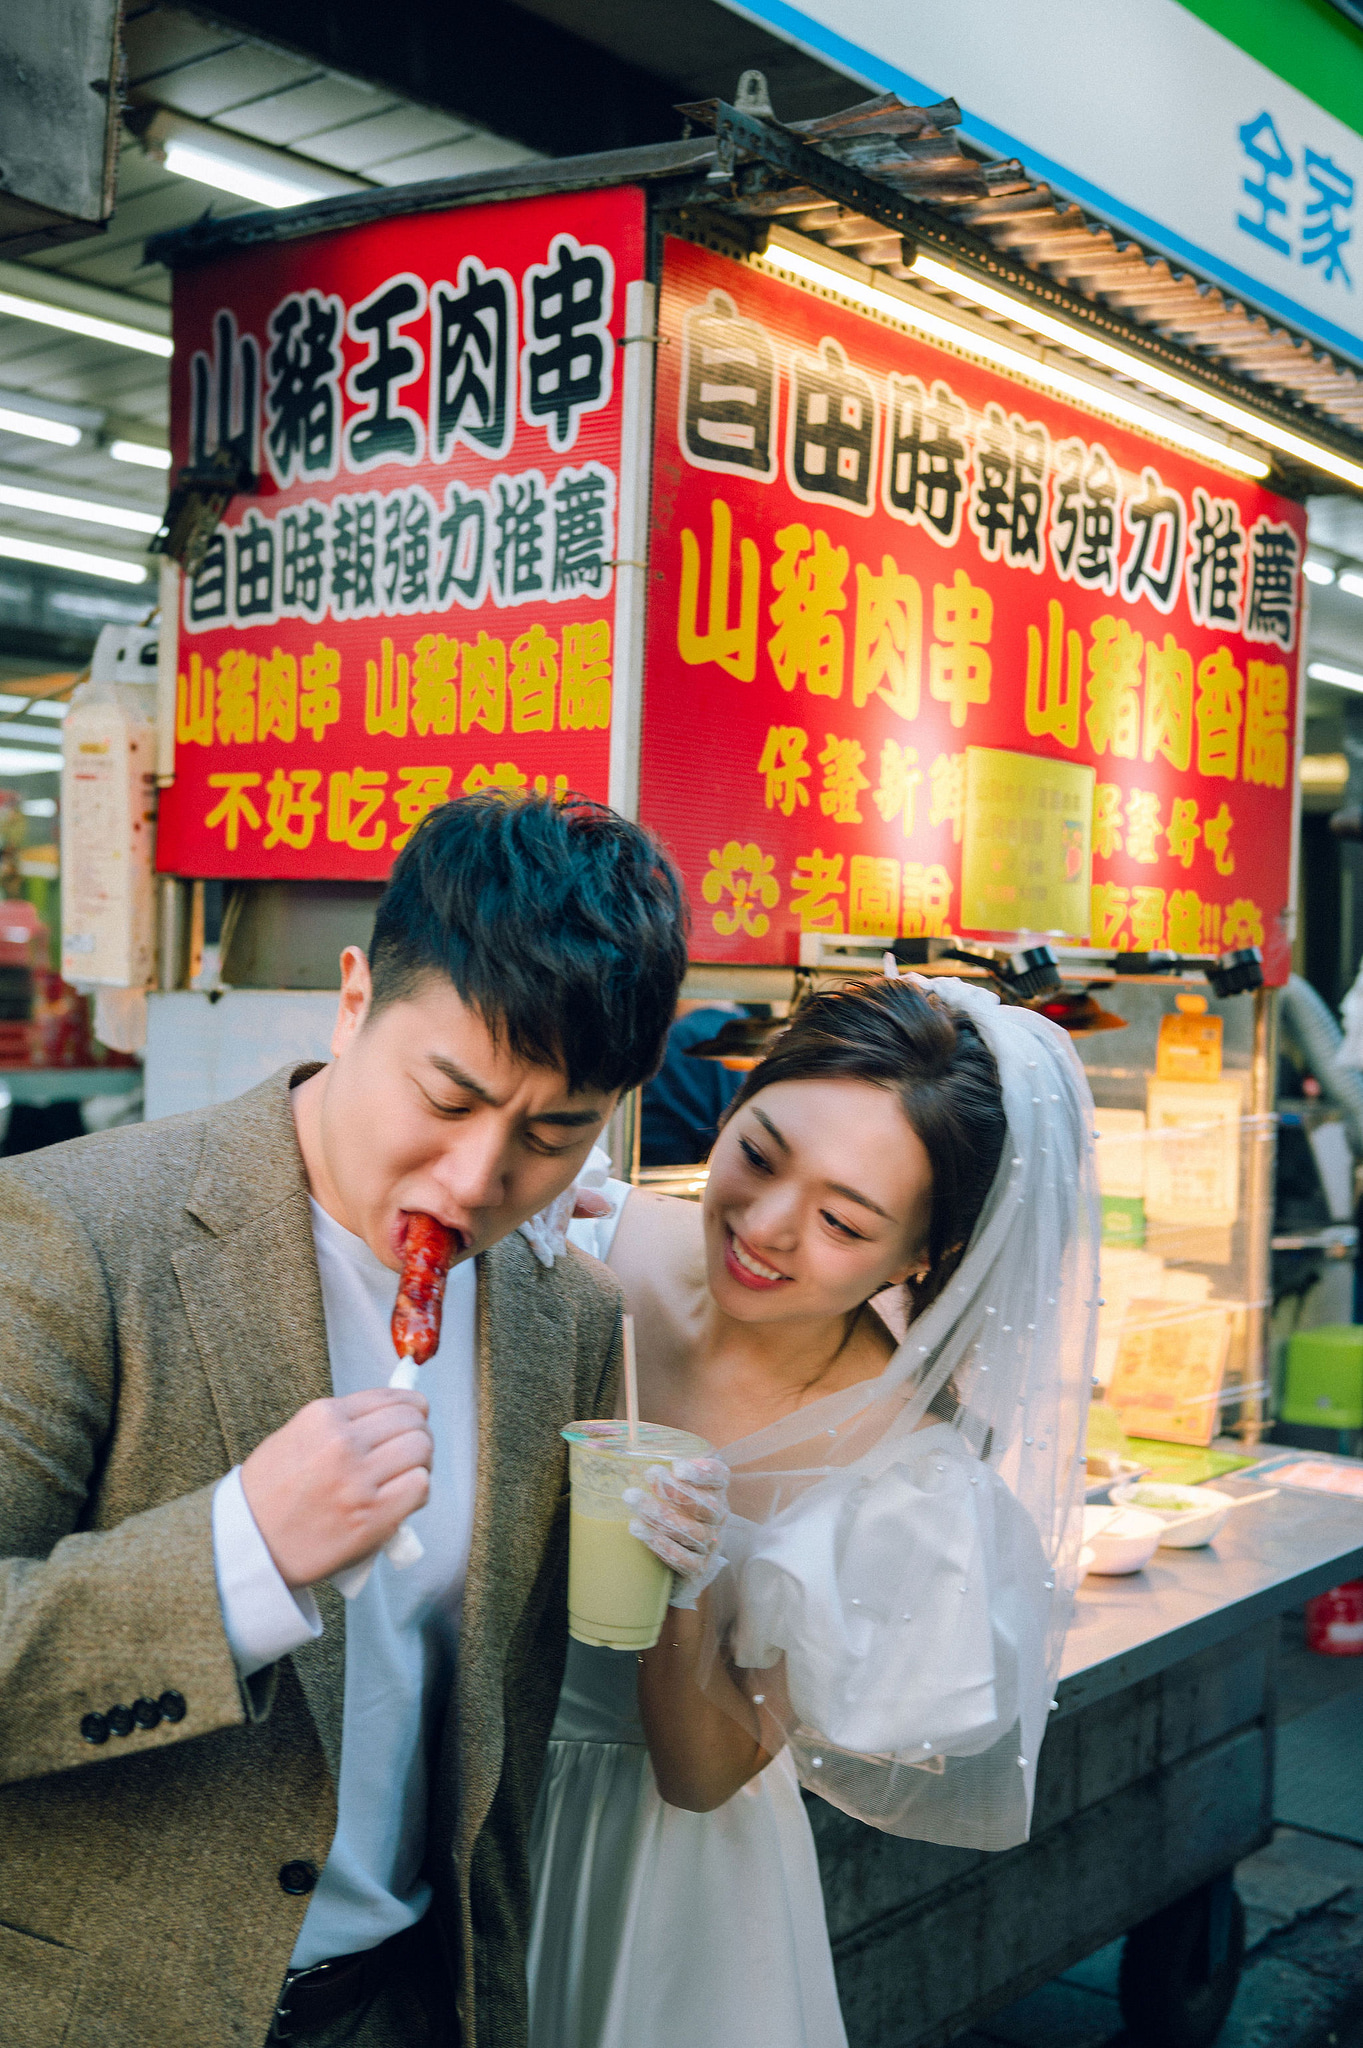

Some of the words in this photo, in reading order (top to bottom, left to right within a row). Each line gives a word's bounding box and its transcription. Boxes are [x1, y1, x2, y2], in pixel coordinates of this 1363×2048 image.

[1236, 110, 1355, 293] 全家
[189, 232, 615, 490] 山豬王肉串
[678, 288, 1298, 654] 自由時報強力推薦
[184, 461, 617, 634] 自由時報強力推薦
[677, 498, 993, 728] 山豬肉串
[1024, 598, 1290, 790] 山豬肉香腸
[176, 641, 342, 747] 山豬肉串
[364, 620, 613, 738] 山豬肉香腸
